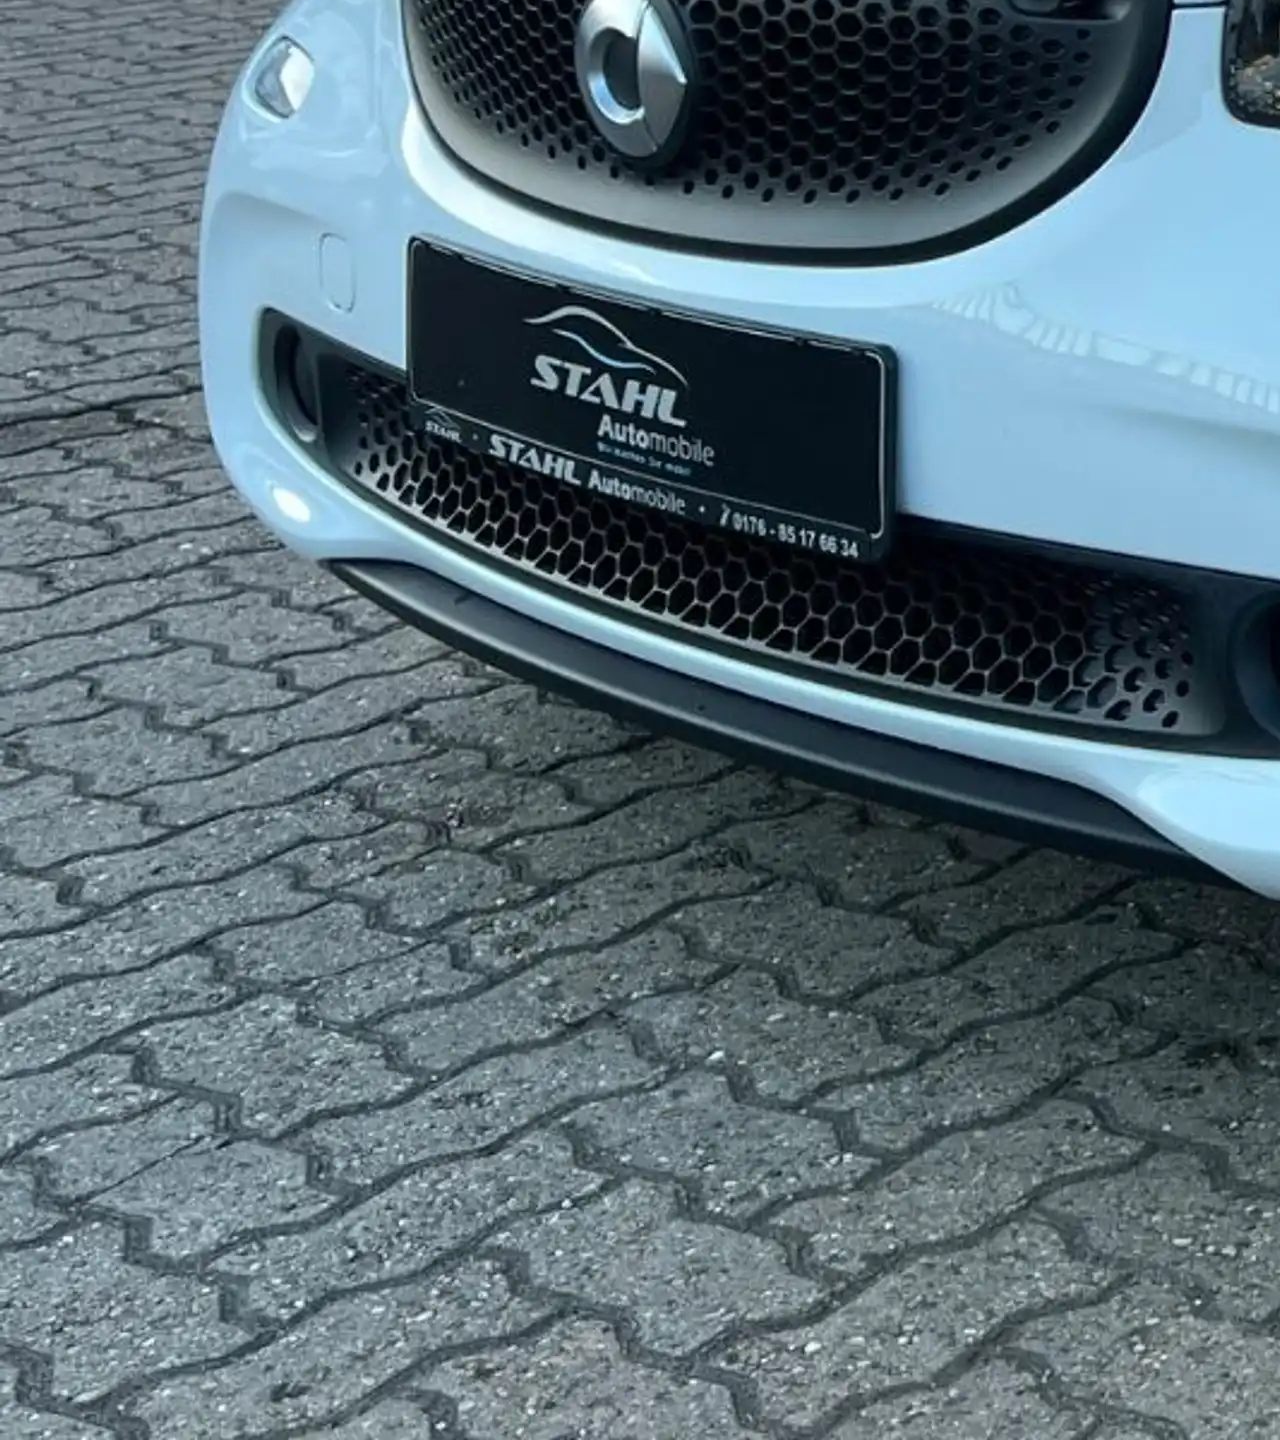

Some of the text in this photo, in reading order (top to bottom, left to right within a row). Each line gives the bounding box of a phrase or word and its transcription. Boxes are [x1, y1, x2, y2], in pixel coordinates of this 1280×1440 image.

[530, 354, 687, 428] STAHL
[597, 414, 715, 467] Automobile
[489, 434, 581, 486] STAHL
[588, 469, 686, 515] Automobile
[799, 528, 816, 549] 17
[839, 538, 859, 559] 34
